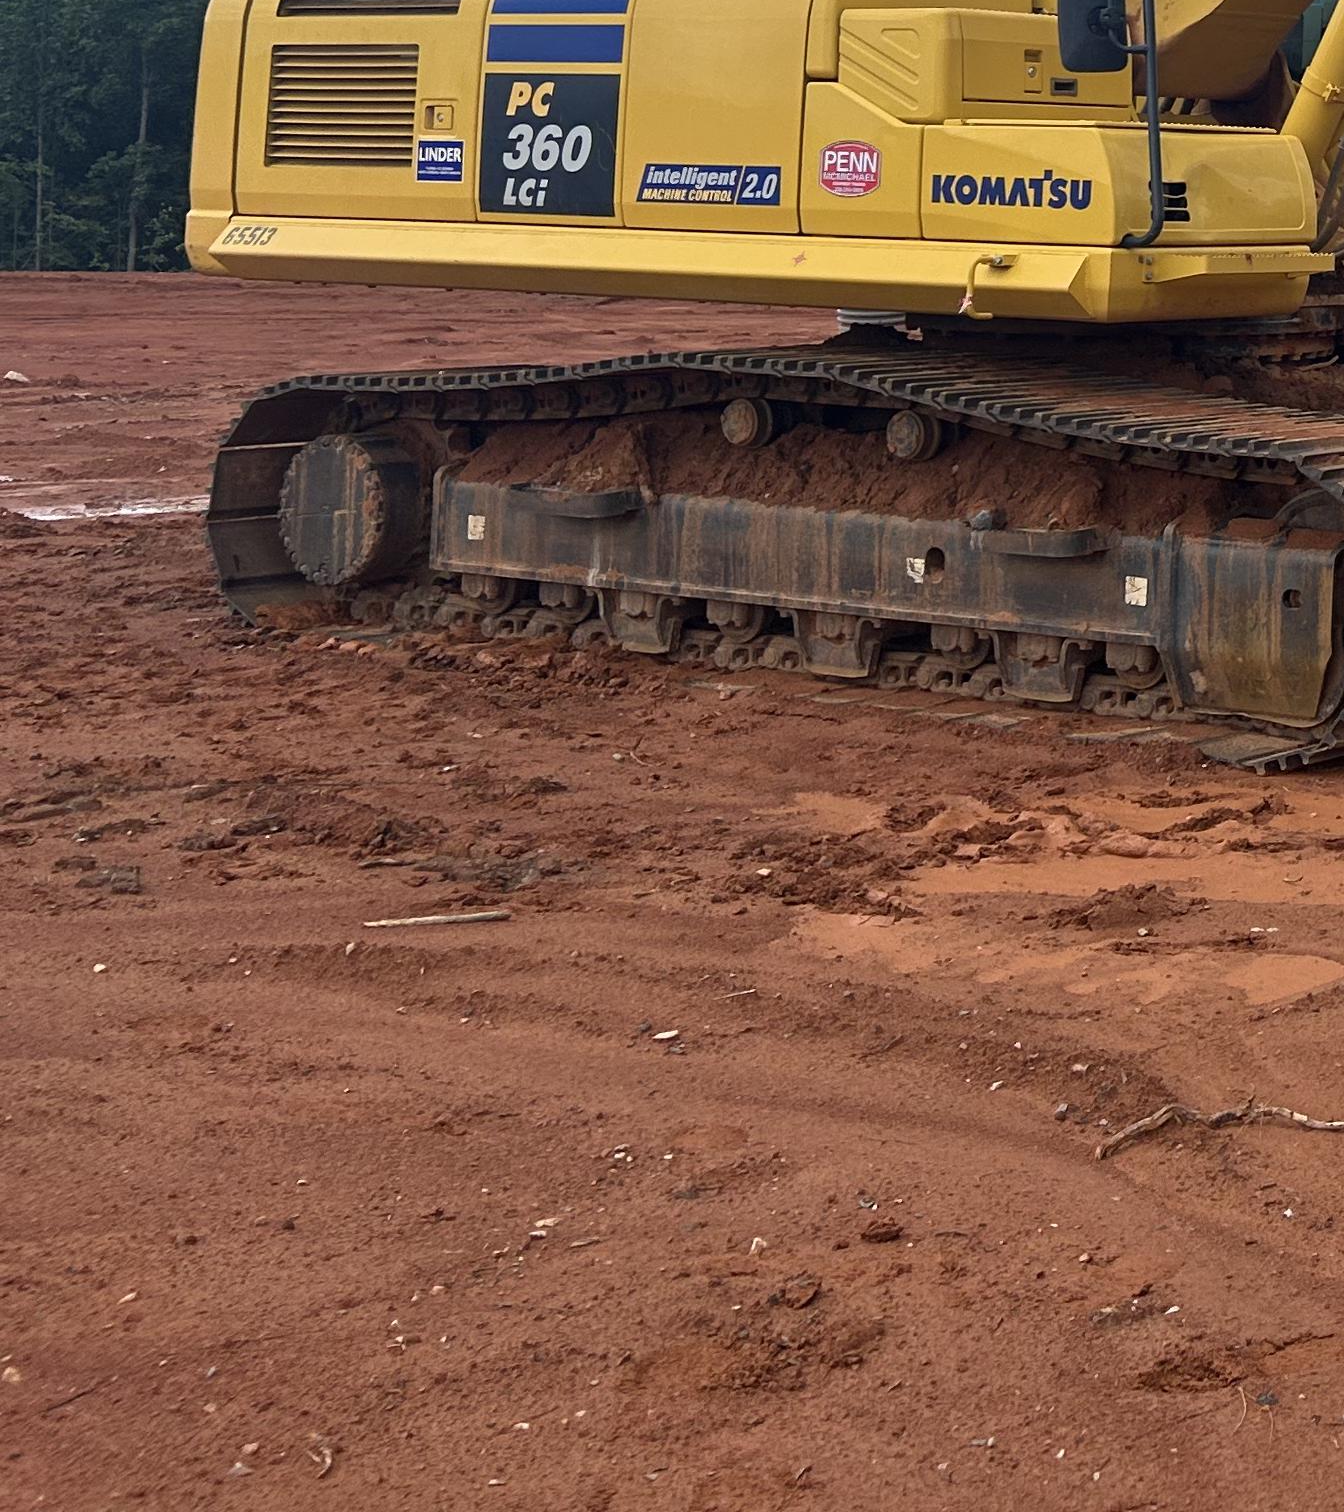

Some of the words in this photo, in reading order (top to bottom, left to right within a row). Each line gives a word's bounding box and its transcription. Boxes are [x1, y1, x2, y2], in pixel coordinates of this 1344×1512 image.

[506, 82, 555, 117] PC
[419, 147, 461, 163] LINDER
[503, 123, 593, 173] 360
[823, 150, 878, 173] PENN
[503, 177, 549, 207] LCi
[642, 188, 687, 201] MACHINE
[688, 190, 732, 202] CONTROL
[646, 166, 738, 189] intelligent
[742, 173, 778, 199] 2.0
[931, 169, 1092, 210] KOMATSU
